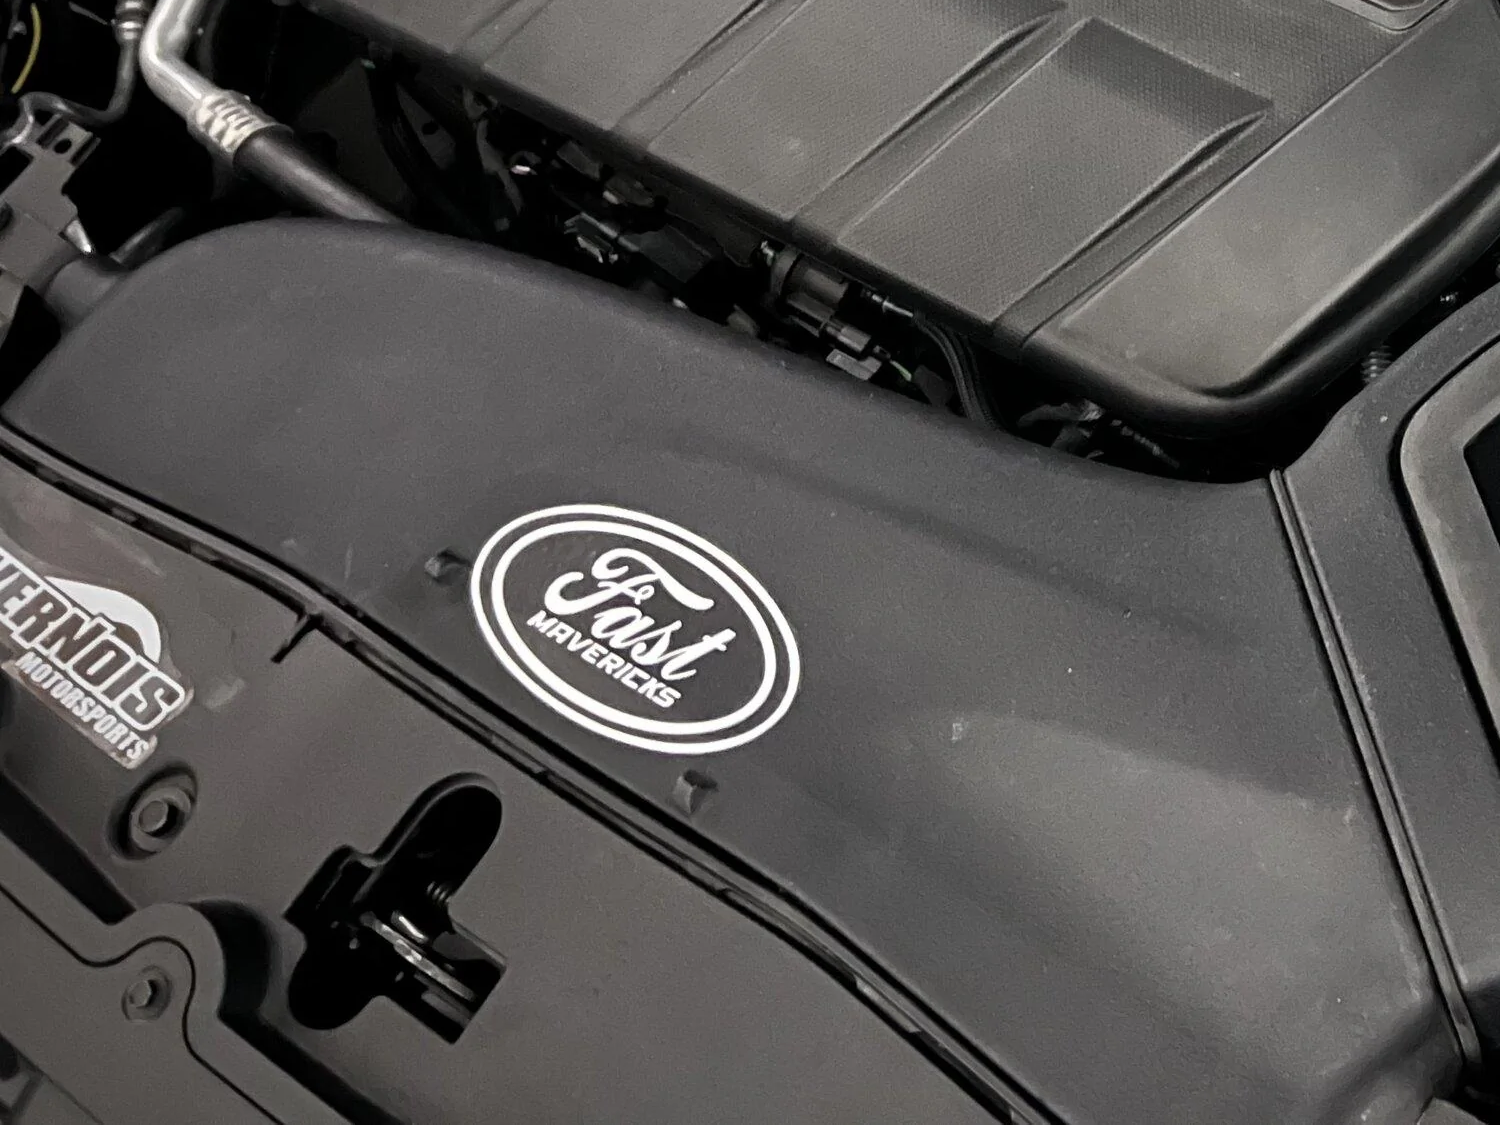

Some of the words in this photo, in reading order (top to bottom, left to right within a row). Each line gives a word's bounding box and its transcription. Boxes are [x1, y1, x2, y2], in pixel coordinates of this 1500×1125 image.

[0, 547, 186, 731] ERNOIS
[526, 610, 682, 708] MAVERICKS
[544, 548, 737, 681] Fast
[15, 651, 149, 760] MOTORSPORTS
